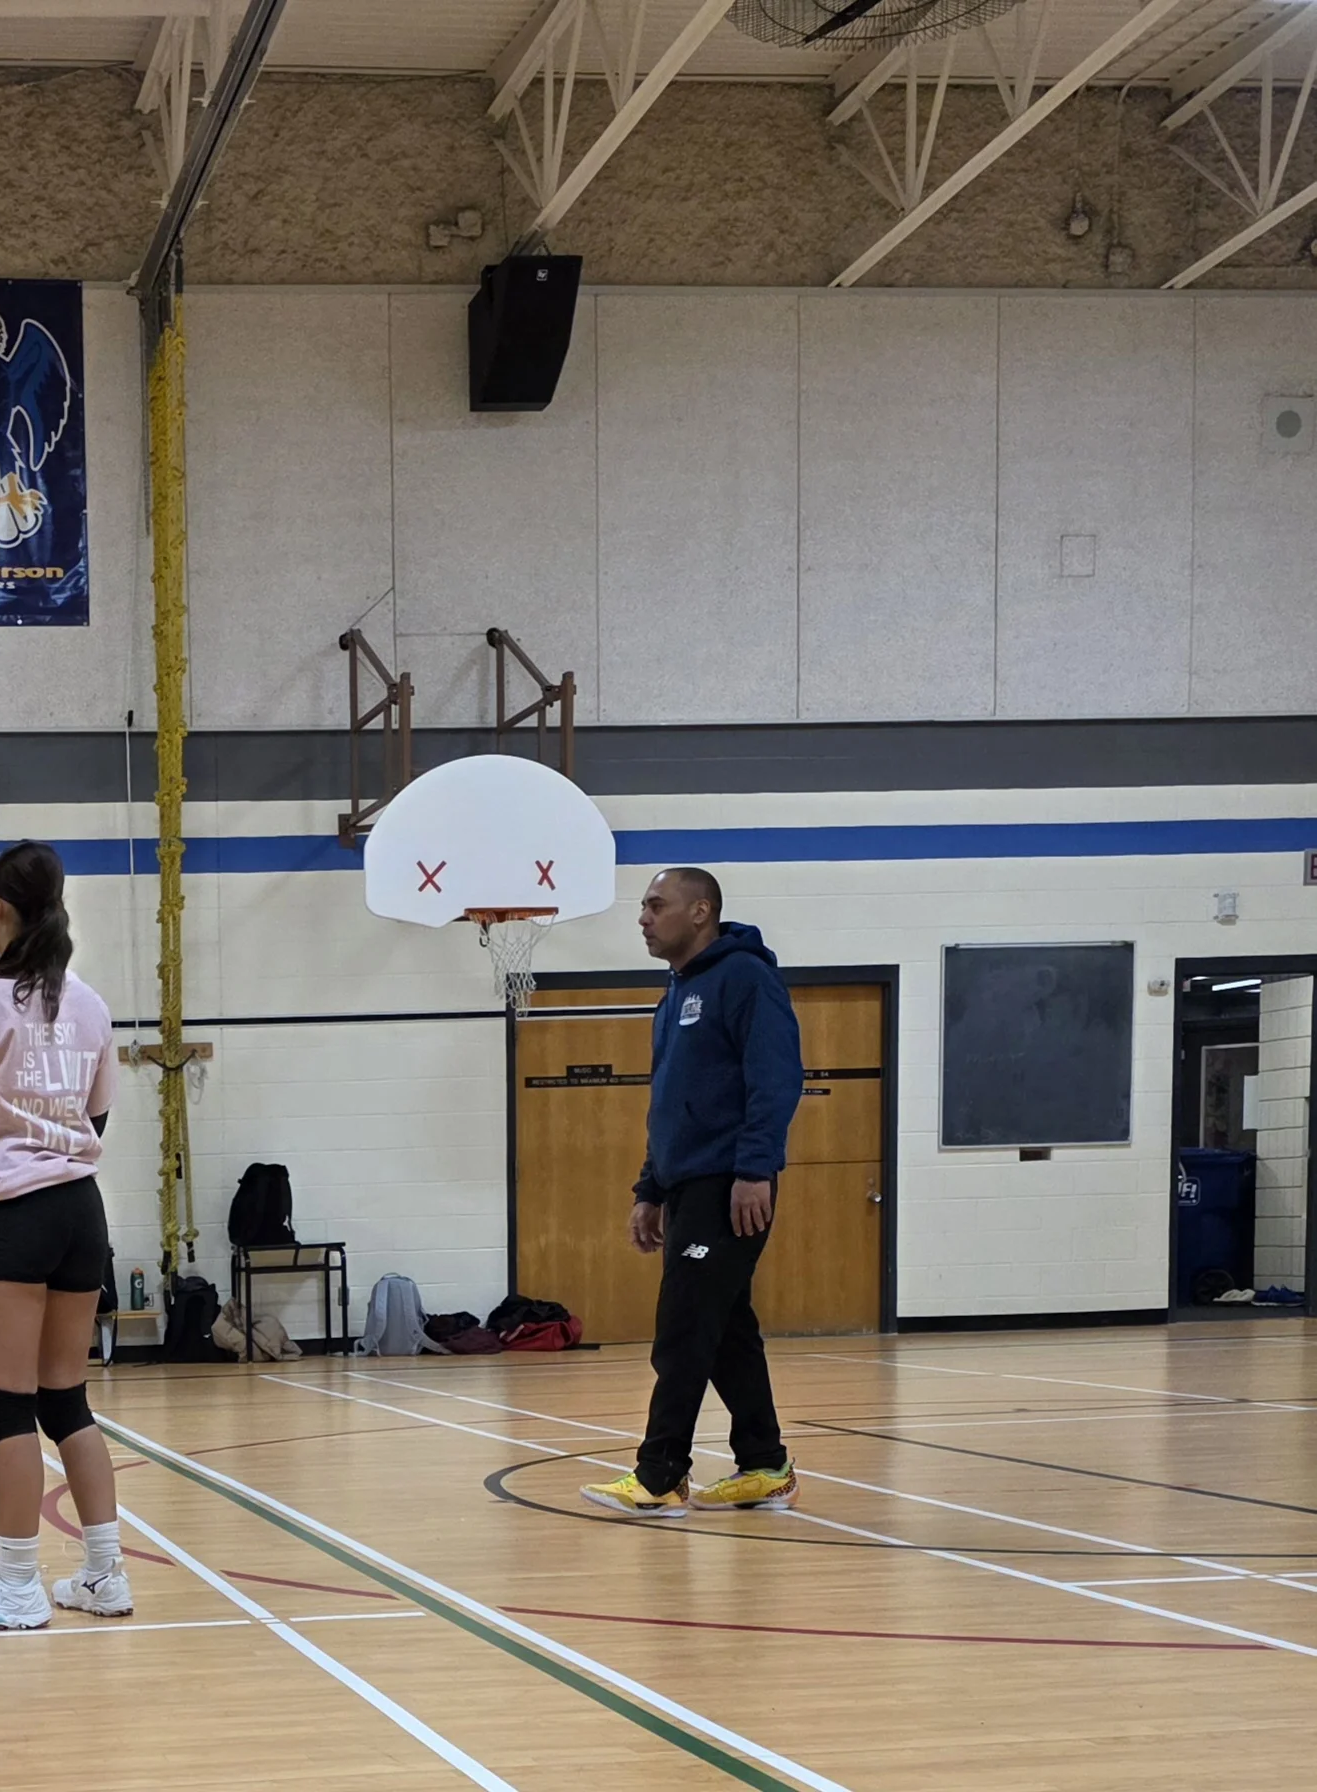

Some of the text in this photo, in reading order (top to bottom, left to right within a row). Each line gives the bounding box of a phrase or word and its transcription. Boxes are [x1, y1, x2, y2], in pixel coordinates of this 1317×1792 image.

[25, 1023, 51, 1046] THE
[23, 1051, 35, 1069] IS
[16, 1070, 43, 1087] THE
